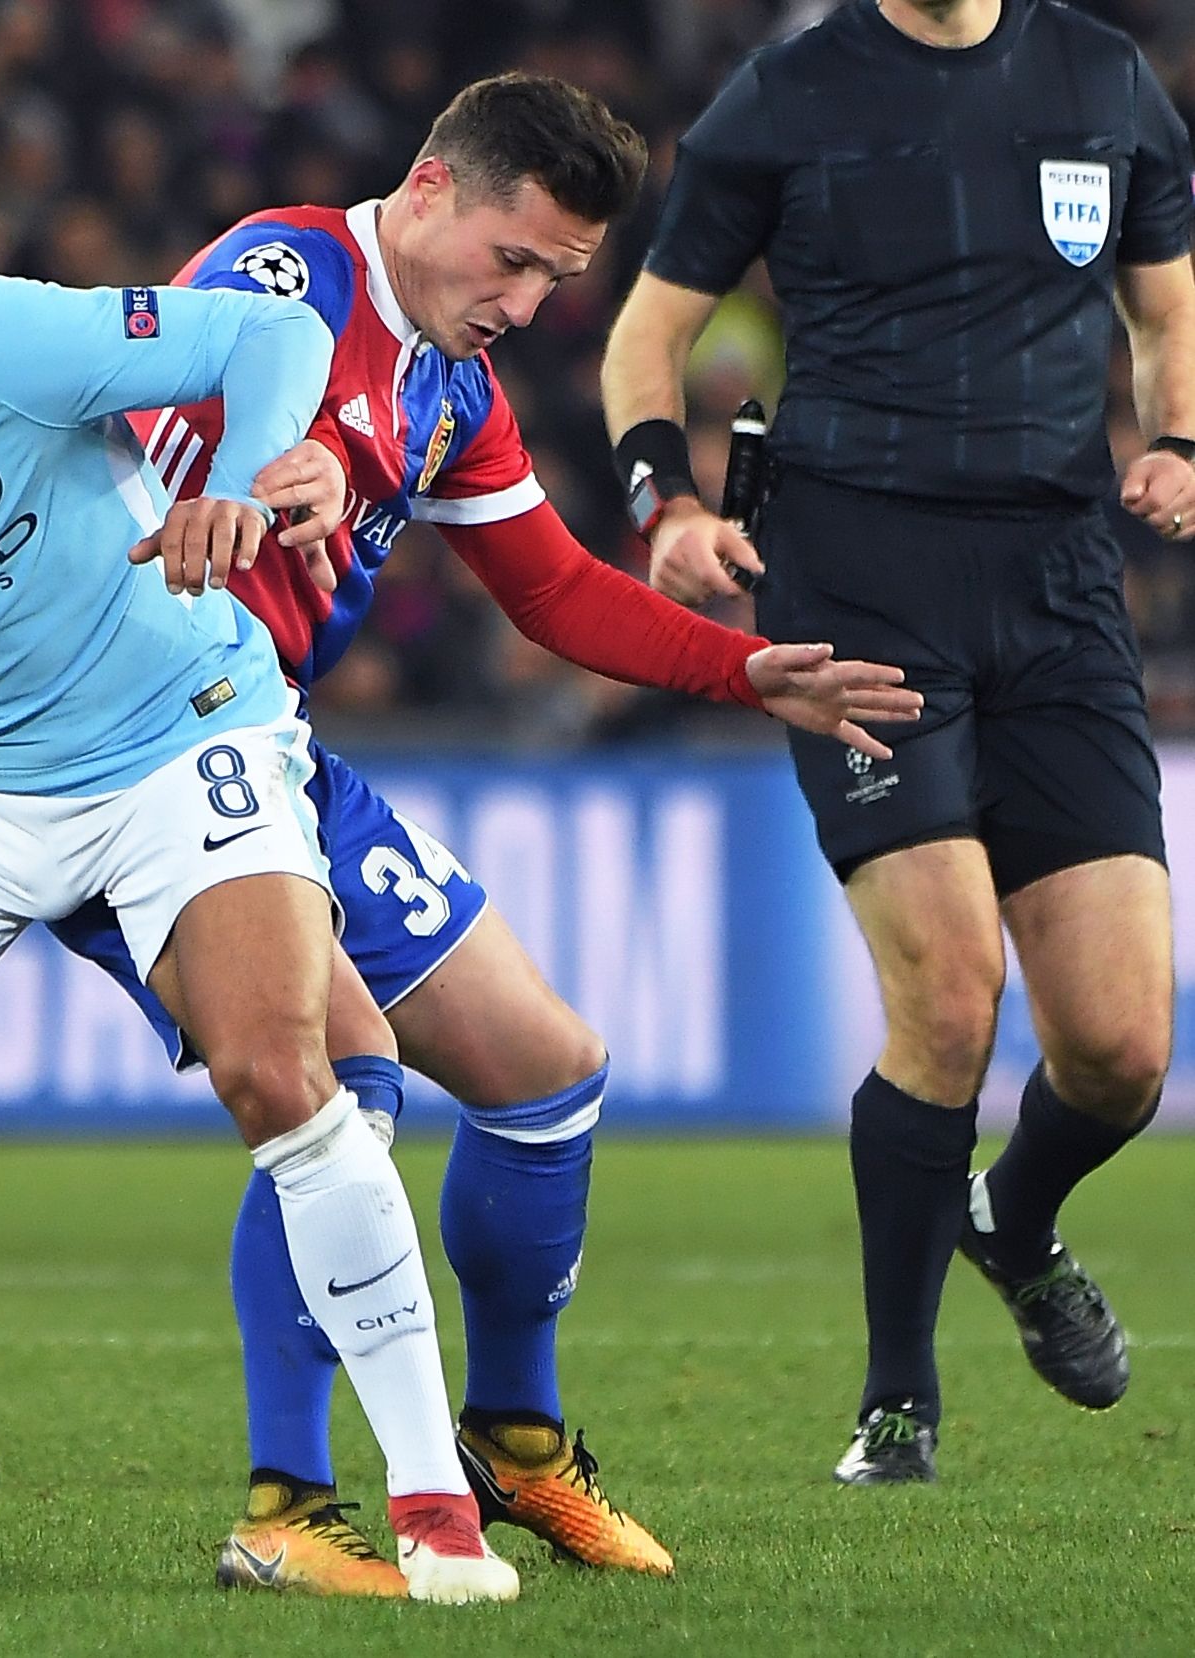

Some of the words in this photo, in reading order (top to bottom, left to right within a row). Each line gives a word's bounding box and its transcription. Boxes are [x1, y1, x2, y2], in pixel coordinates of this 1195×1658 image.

[1053, 201, 1101, 224] FIFA
[196, 744, 261, 819] 8
[360, 811, 473, 937] 34
[355, 1300, 418, 1331] CITY
